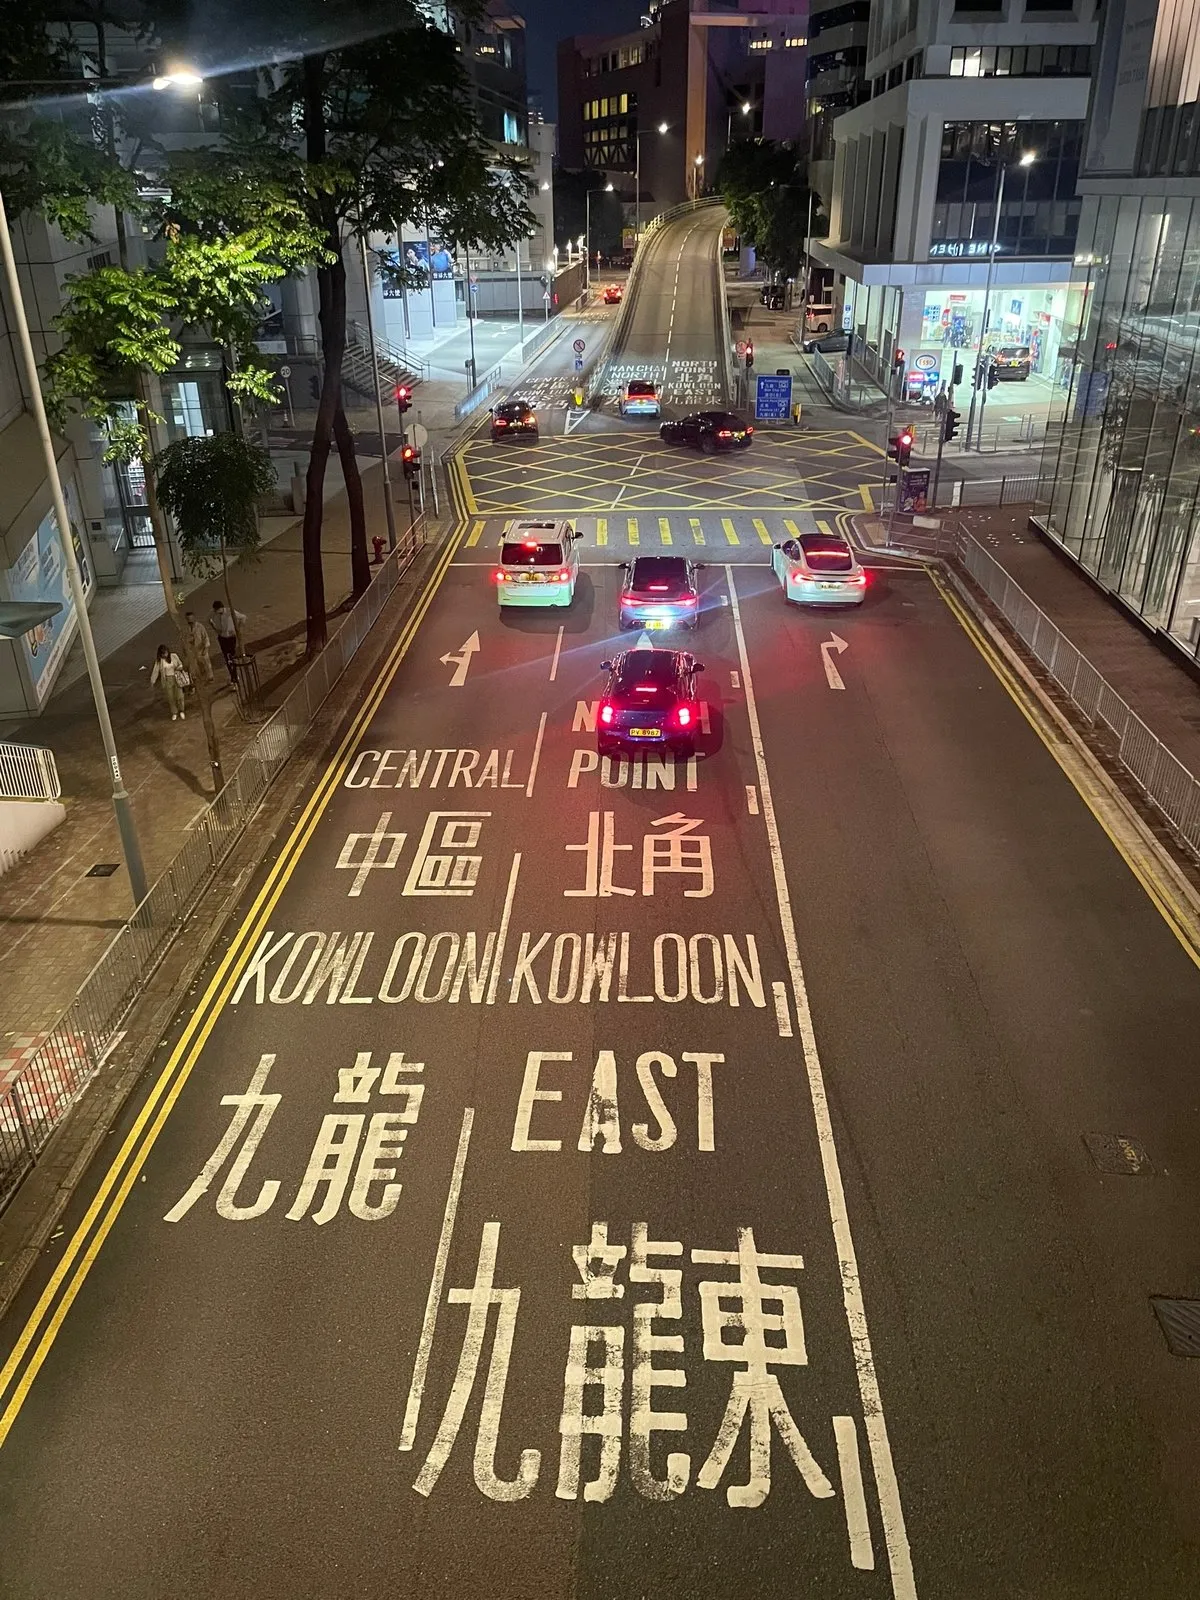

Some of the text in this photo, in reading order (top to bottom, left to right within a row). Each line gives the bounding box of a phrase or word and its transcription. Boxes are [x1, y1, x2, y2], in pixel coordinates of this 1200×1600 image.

[344, 750, 525, 789] CENTRAL
[567, 749, 705, 791] POINT
[335, 812, 492, 897] 中區
[563, 811, 714, 899] 北角
[230, 931, 496, 1005] KOWLOON
[508, 932, 767, 1008] KOWLOON
[163, 1051, 425, 1223] 九龍
[510, 1050, 725, 1153] EAST
[412, 1221, 836, 1508] 九龍東
